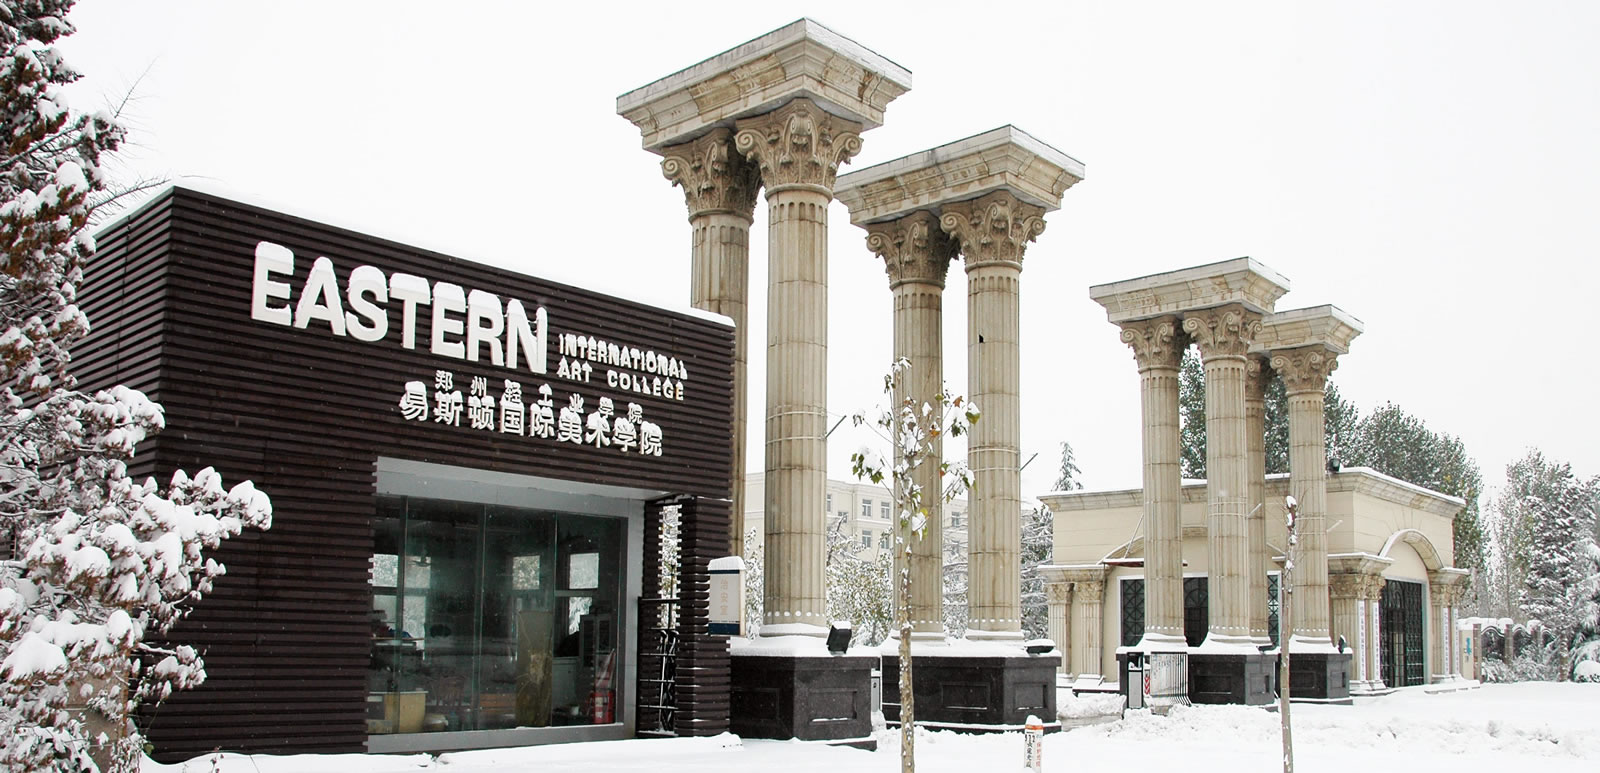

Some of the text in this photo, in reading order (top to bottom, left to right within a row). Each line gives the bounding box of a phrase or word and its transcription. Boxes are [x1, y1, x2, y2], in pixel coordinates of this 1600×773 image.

[251, 240, 547, 374] EASTERN
[557, 356, 685, 401] ART COLLEGE
[558, 333, 688, 380] INTERNATIONAL
[399, 380, 663, 456] 易斯顿国际美术学院
